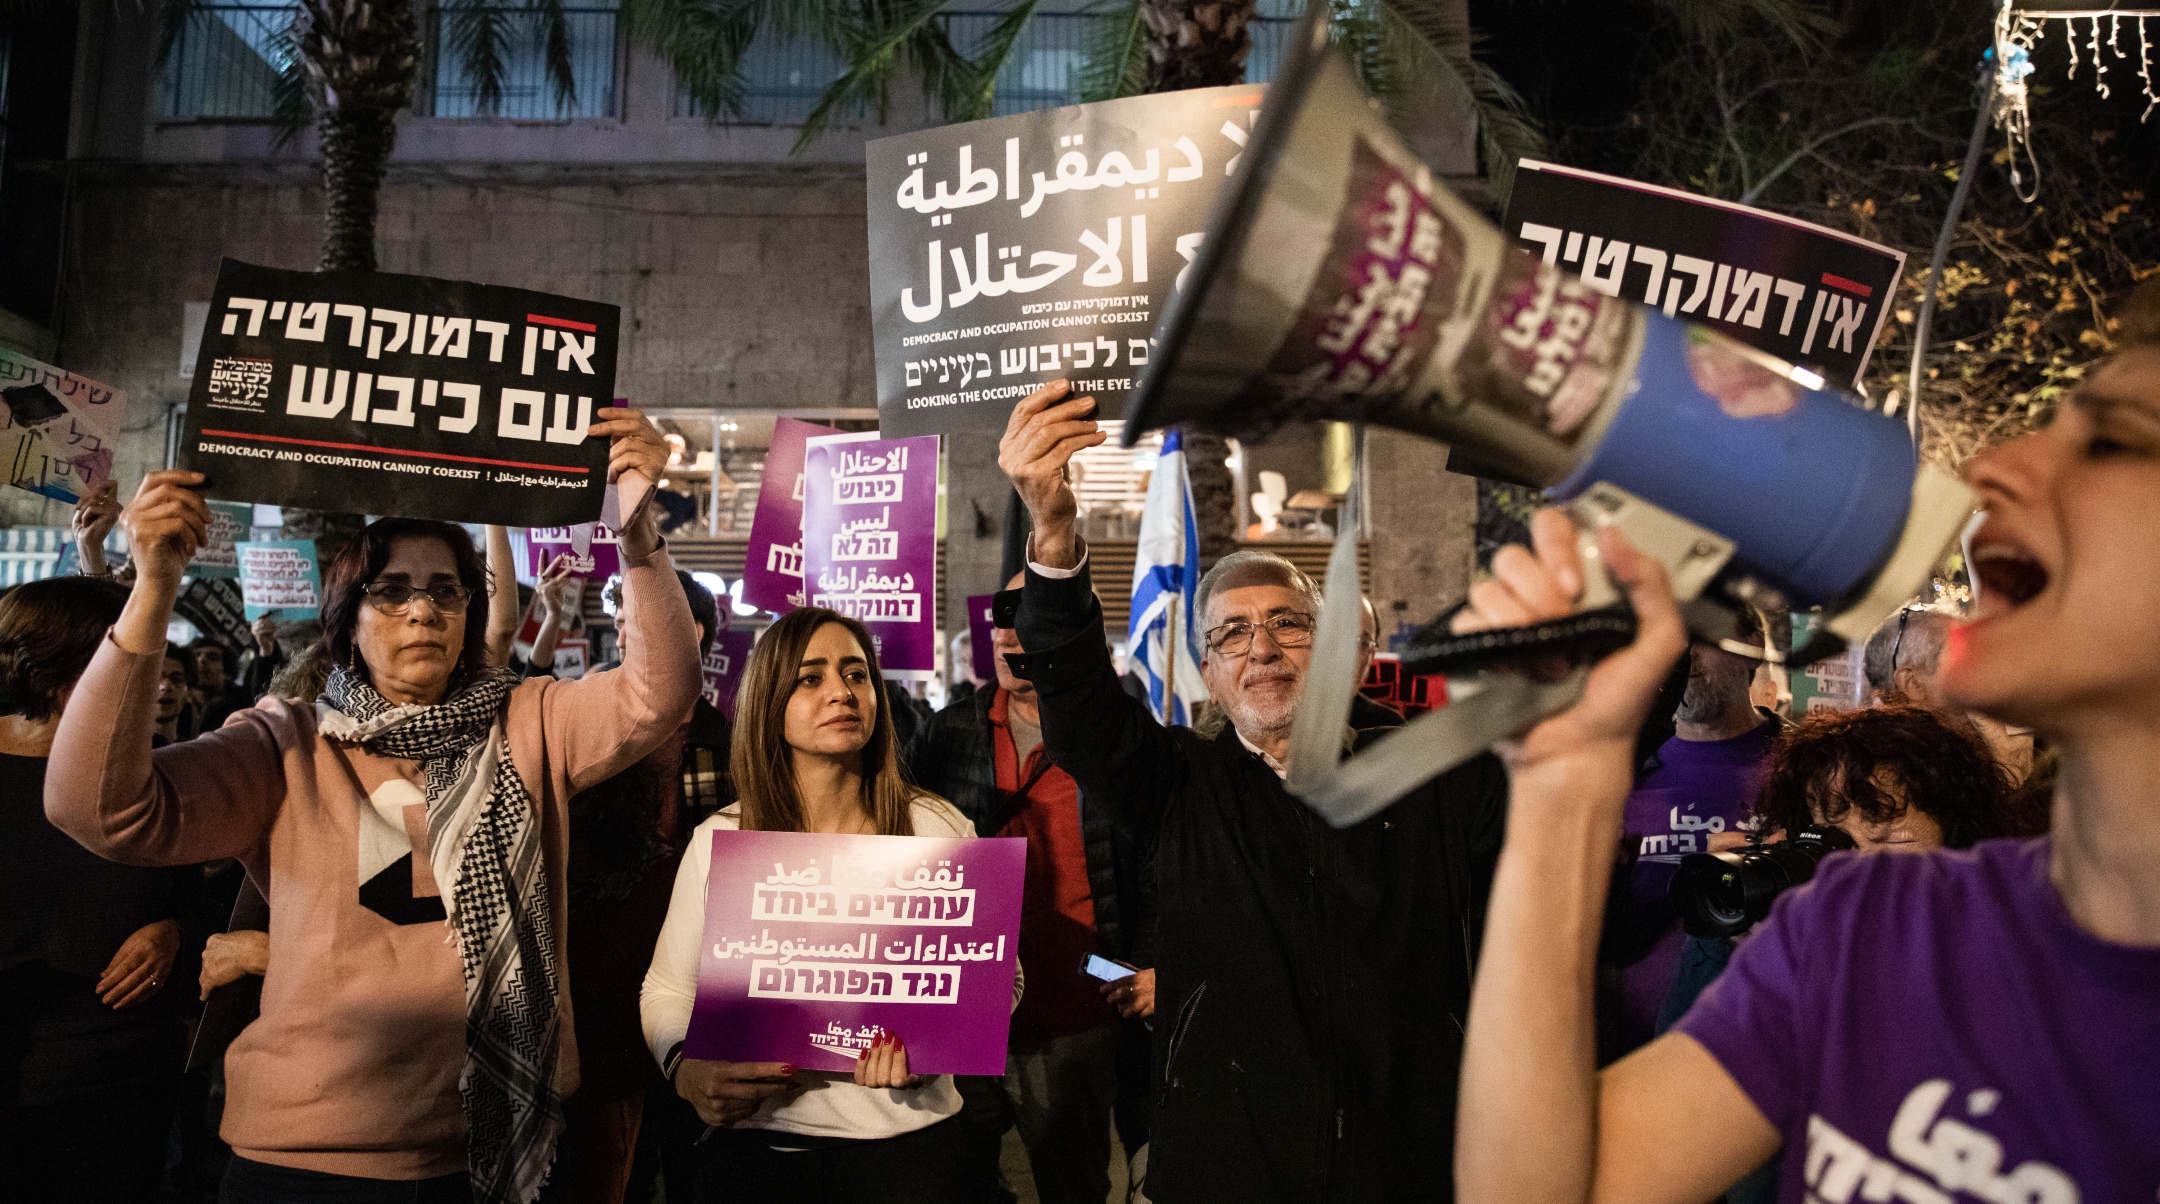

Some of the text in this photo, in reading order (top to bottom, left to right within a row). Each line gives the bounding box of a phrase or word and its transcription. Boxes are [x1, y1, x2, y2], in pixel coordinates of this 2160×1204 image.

[896, 133, 1203, 227] ديمقراطية
[900, 214, 1149, 323] الاحتلال
[1022, 295, 1149, 315] אין דמוקרטיה עם כיבוש
[221, 297, 595, 376] אין דמוקרטיה
[902, 311, 1150, 347] DEMOCRACY AND OCCUPATION CANNOT COEXIST
[1800, 289, 1868, 354] אין
[213, 356, 273, 373] מסתכלים
[904, 352, 992, 388] בעיניים
[1000, 336, 1118, 376] לכיבוש
[208, 380, 269, 400] בעיניים
[211, 369, 272, 385] לכיבוש
[286, 364, 593, 445] עם כיבוש
[907, 390, 957, 410] LOOKING
[958, 389, 980, 403] THE
[982, 383, 1049, 401] OCCUPATIO
[1077, 379, 1105, 392] THE
[1107, 378, 1131, 391] EYE
[198, 442, 275, 459] DEMOCRACY
[275, 450, 303, 462] AND
[304, 453, 381, 470] OCCUPATION
[382, 461, 431, 475] CANNOT
[432, 467, 481, 480] COEXIST
[830, 446, 908, 480] الاحتلال
[838, 479, 897, 500] כיבוש
[841, 505, 890, 536] ليس
[837, 533, 892, 556] זה לא
[817, 566, 915, 596] ديمقراطية
[1799, 832, 1822, 840] Nikon
[766, 858, 821, 886] ضد
[895, 859, 964, 890] نقف
[758, 889, 970, 921] עומדים ביחד
[713, 929, 1006, 964] اعتداءات المستوطنين
[757, 967, 953, 997] נגד הפוגרום
[809, 1033, 873, 1049] מדים ביחד
